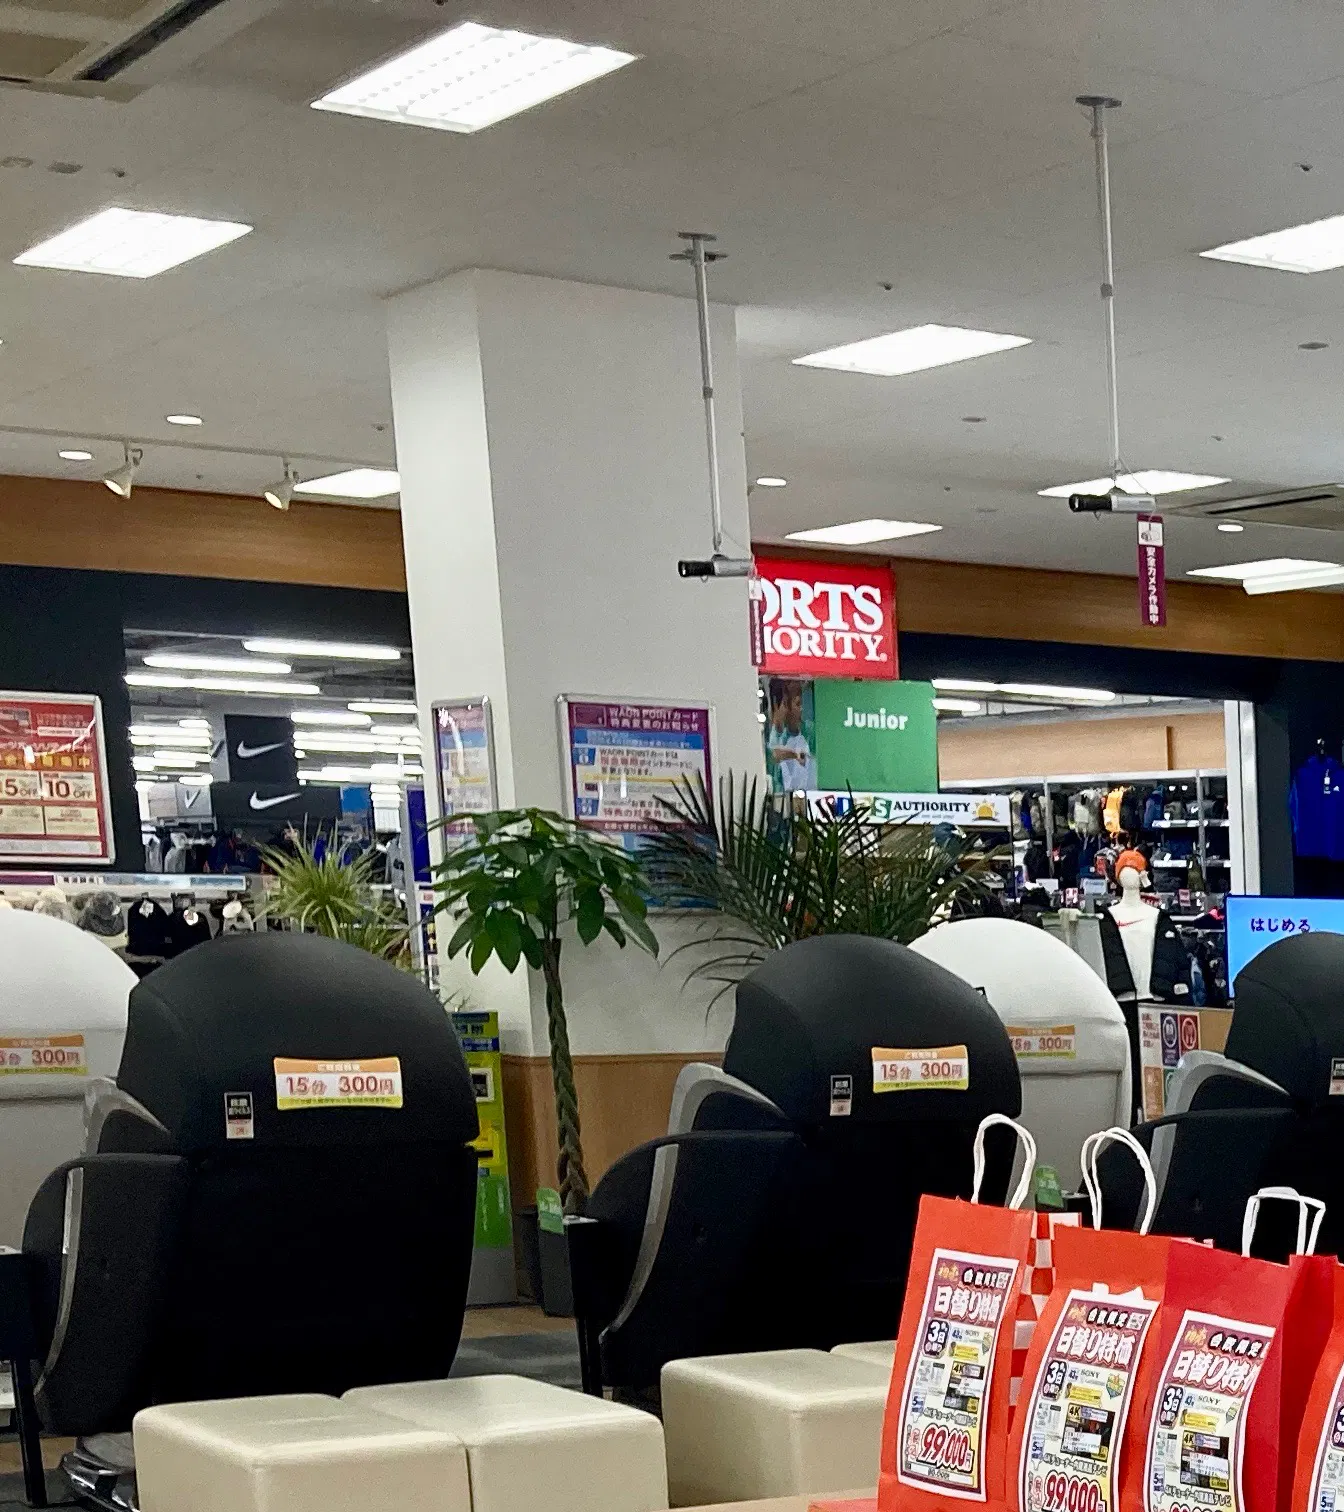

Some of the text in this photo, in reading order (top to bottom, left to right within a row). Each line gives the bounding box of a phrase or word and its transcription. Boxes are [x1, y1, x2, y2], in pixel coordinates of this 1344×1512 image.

[844, 707, 909, 730] Junior
[46, 781, 70, 798] 10
[1251, 917, 1311, 933] はじめる
[880, 1062, 963, 1079] 15分 300円
[286, 1075, 394, 1095] 15分 300円
[934, 1285, 1001, 1322] 日替り特価
[1057, 1326, 1136, 1366] 日替り特価
[920, 1424, 974, 1472] 99,000円
